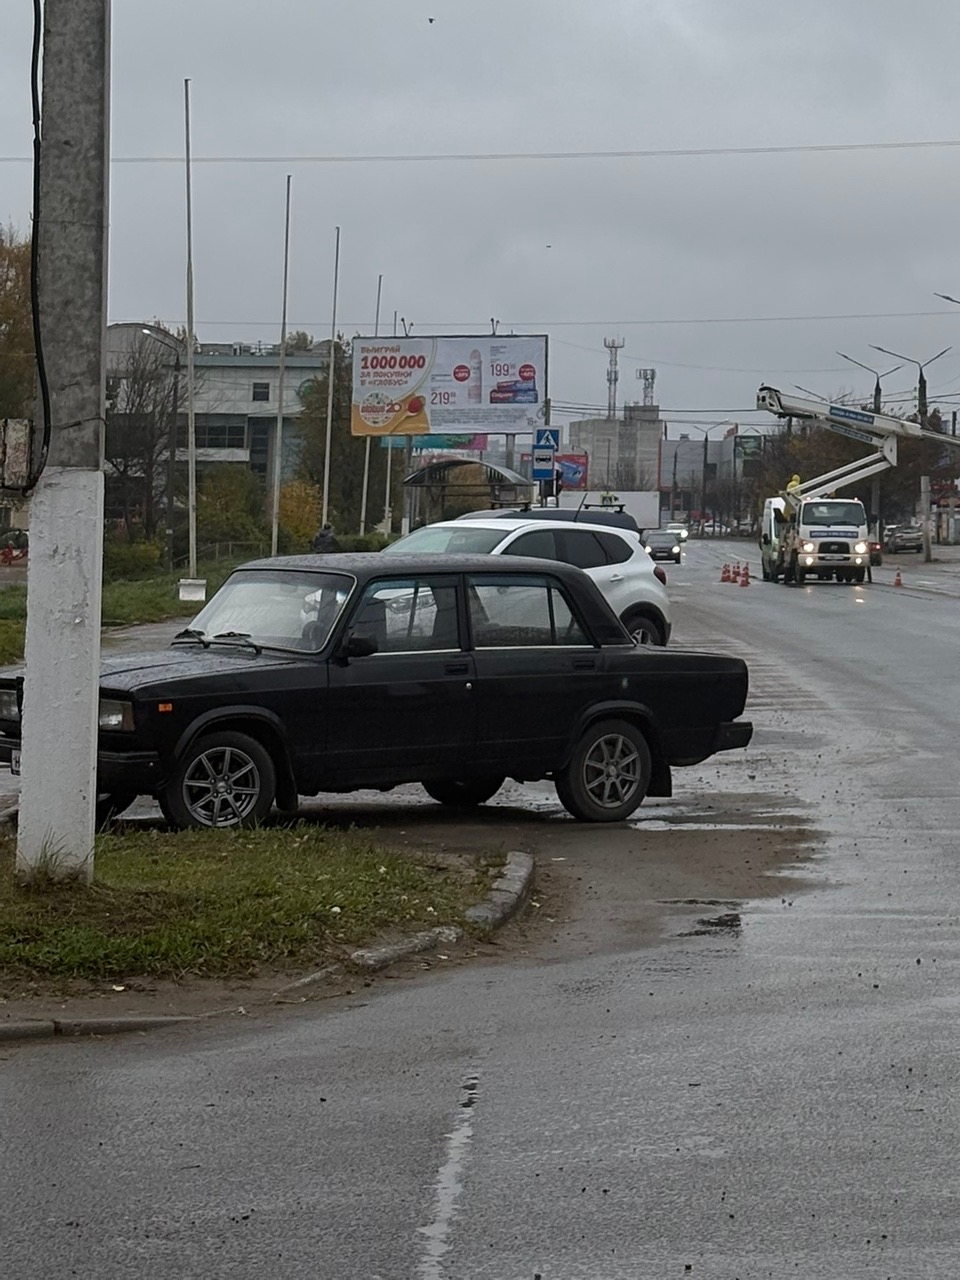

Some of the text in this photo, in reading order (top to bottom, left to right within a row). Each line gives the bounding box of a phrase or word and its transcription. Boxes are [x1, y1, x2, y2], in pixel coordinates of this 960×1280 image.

[361, 345, 400, 353] ВЫИГРАЙ
[361, 355, 426, 369] 1000 000
[360, 371, 412, 379] ЗА ПОКУПКИ
[490, 363, 509, 376] 199
[430, 391, 450, 405] 219
